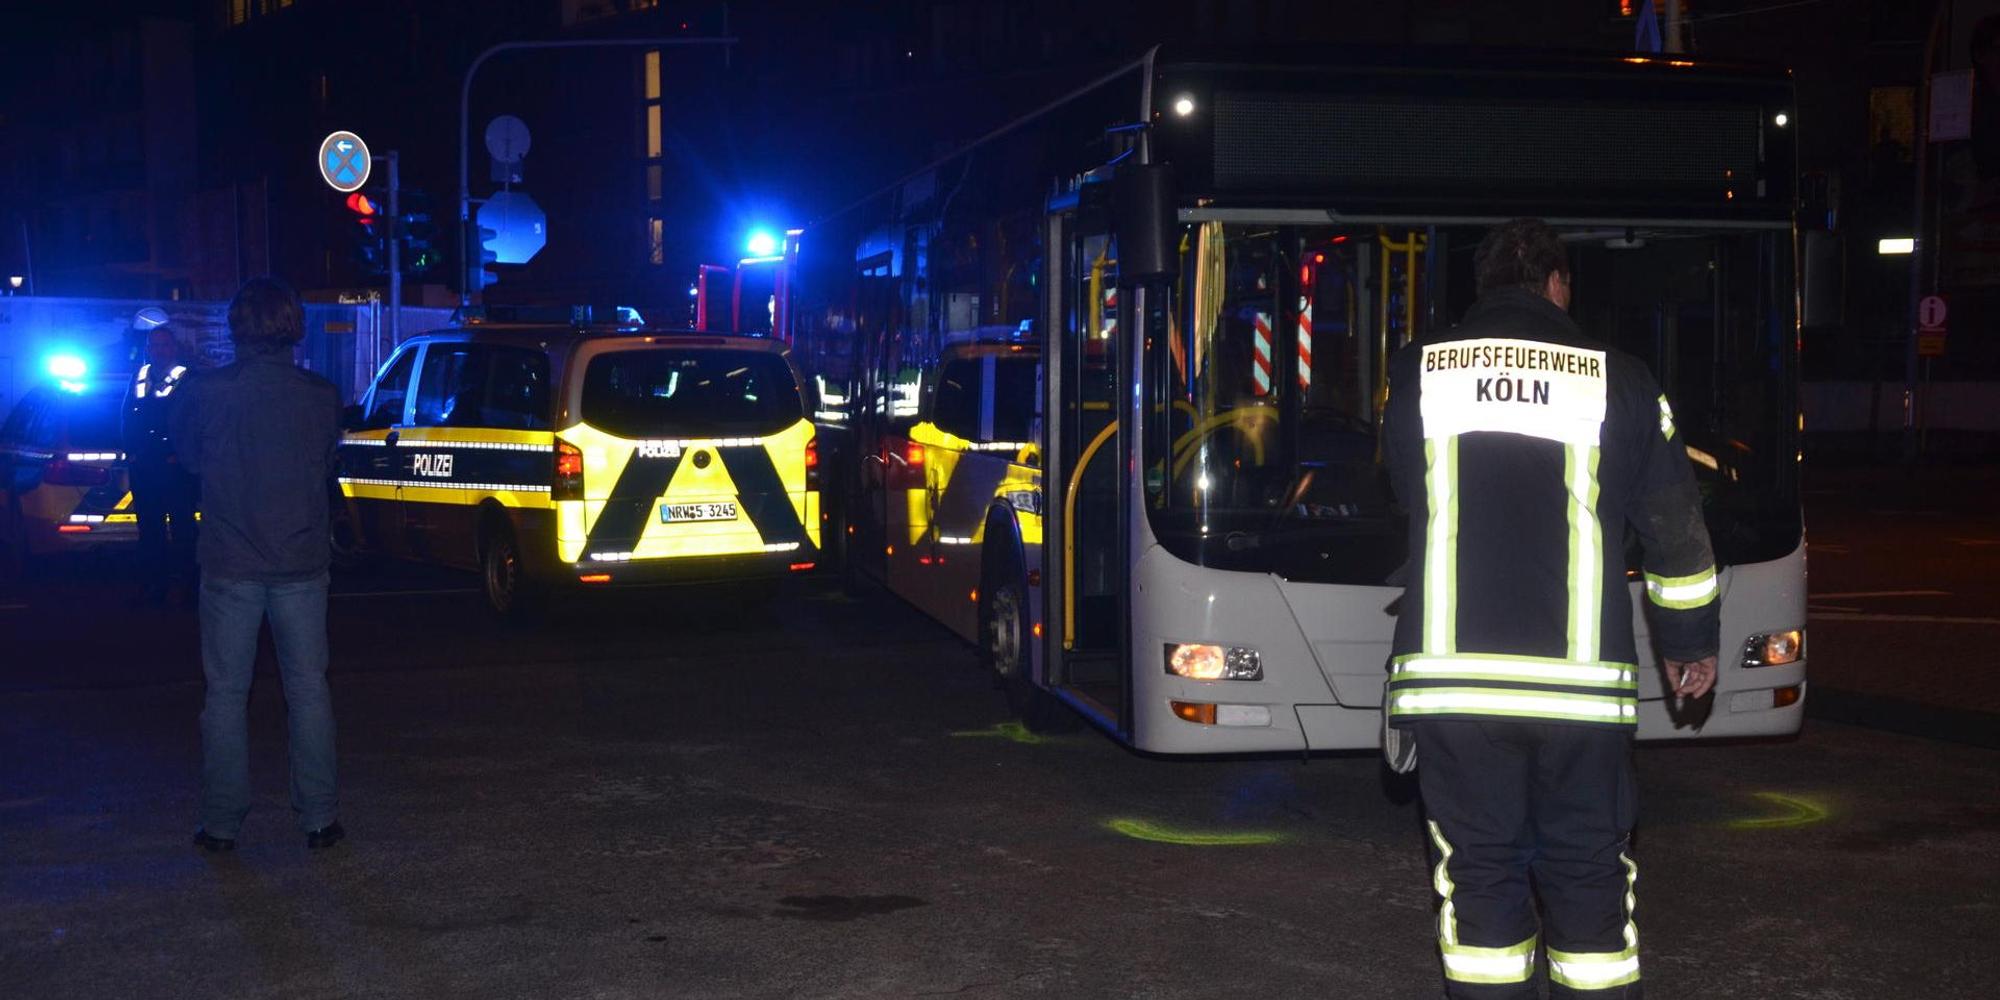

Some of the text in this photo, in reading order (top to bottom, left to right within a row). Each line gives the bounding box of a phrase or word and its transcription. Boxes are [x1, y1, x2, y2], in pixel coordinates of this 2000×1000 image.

[1426, 346, 1600, 378] BERUFSFEUERWEHR
[1476, 372, 1550, 405] KÖLN
[413, 453, 454, 477] POLIZEI
